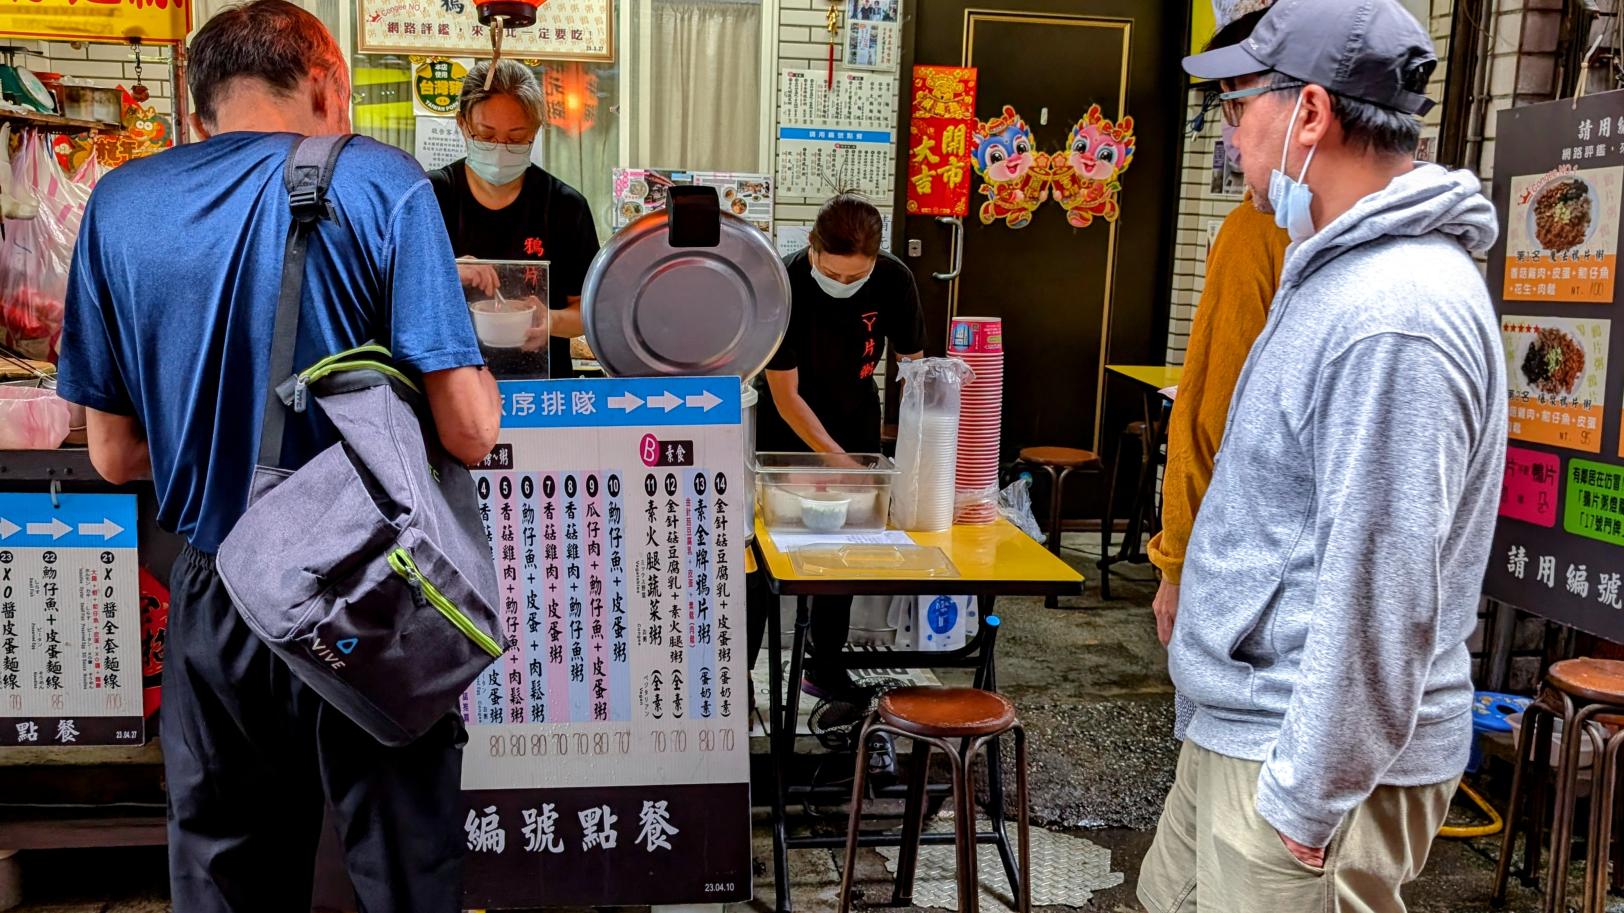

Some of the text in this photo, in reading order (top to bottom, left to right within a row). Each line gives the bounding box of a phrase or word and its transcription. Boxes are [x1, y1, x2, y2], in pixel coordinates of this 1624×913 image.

[911, 136, 941, 195] 大吉
[937, 124, 967, 189] 開市
[312, 638, 346, 669] VIVE
[16, 720, 80, 742] 點餐
[489, 728, 735, 757] 80 80 80 70 70 80 70 70 70 80 70
[464, 800, 680, 853] 編號點餐
[704, 883, 735, 892] 23.04.10
